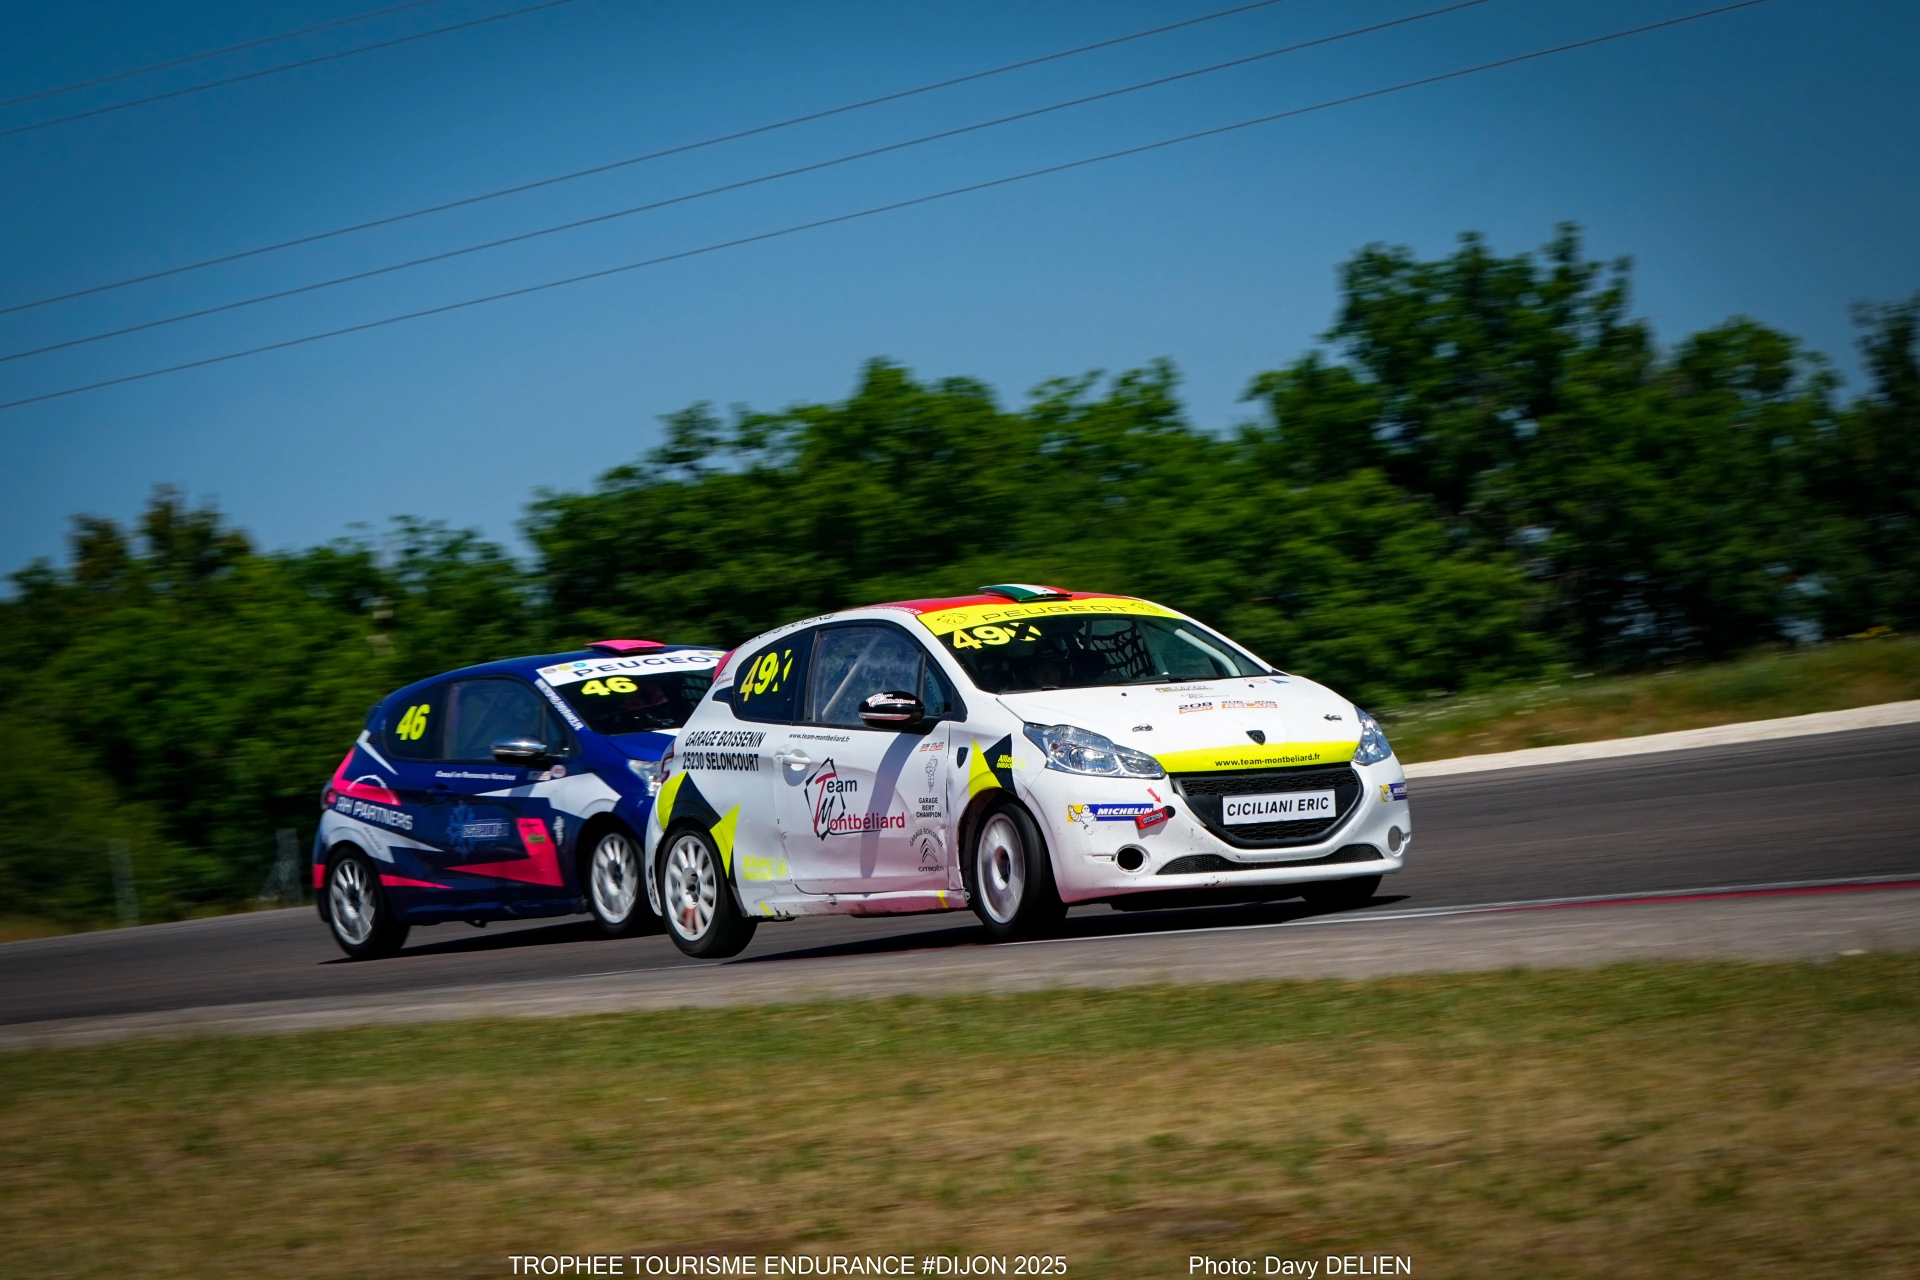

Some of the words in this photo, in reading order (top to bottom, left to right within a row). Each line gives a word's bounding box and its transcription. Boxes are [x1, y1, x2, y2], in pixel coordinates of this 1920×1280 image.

[982, 605, 1127, 621] PEUGEOT
[581, 677, 639, 696] 46
[395, 704, 430, 740] 46
[685, 731, 720, 747] GARAGE
[717, 731, 767, 748] BOISSENIN
[789, 733, 851, 743] www.team-montbeliard.fr
[682, 752, 705, 770] 25230
[706, 752, 759, 772] SELONCOURT
[1215, 753, 1321, 767] www.team-montbeliard.fr
[352, 801, 413, 830] PARTNERS
[818, 796, 906, 836] Montbéliard
[1097, 807, 1153, 815] MICHELIN
[1227, 800, 1292, 816] CICILIANI
[1297, 797, 1329, 811] ERIC
